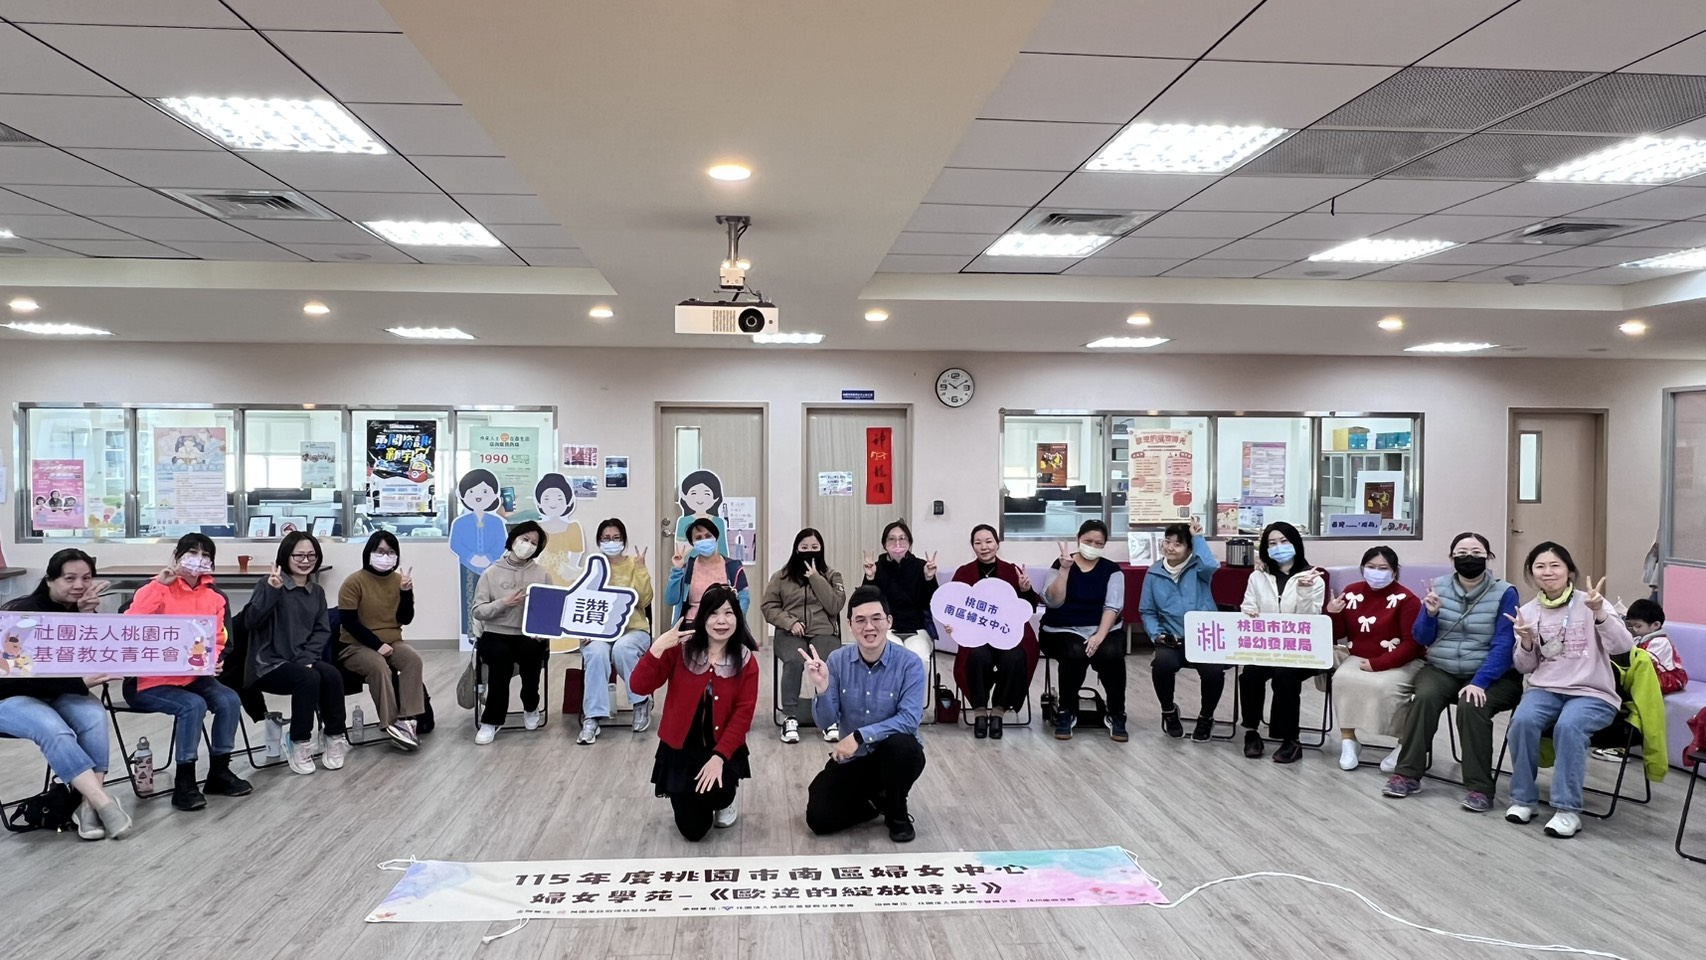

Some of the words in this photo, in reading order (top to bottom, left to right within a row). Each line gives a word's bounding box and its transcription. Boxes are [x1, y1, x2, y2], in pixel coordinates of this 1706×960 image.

[940, 383, 948, 391] 9
[951, 395, 959, 403] 6
[479, 454, 509, 463] 1990
[572, 598, 609, 625] 讚
[965, 596, 999, 615] 桃園市
[944, 604, 1011, 634] 南區婦女中心
[1237, 619, 1311, 635] 桃園市政府
[33, 624, 181, 642] 社團法人桃園市
[1238, 635, 1312, 652] 婦幼發展局
[32, 646, 180, 663] 基督教女青年會
[515, 863, 1028, 885] 115年度桃園市南區婦女中心
